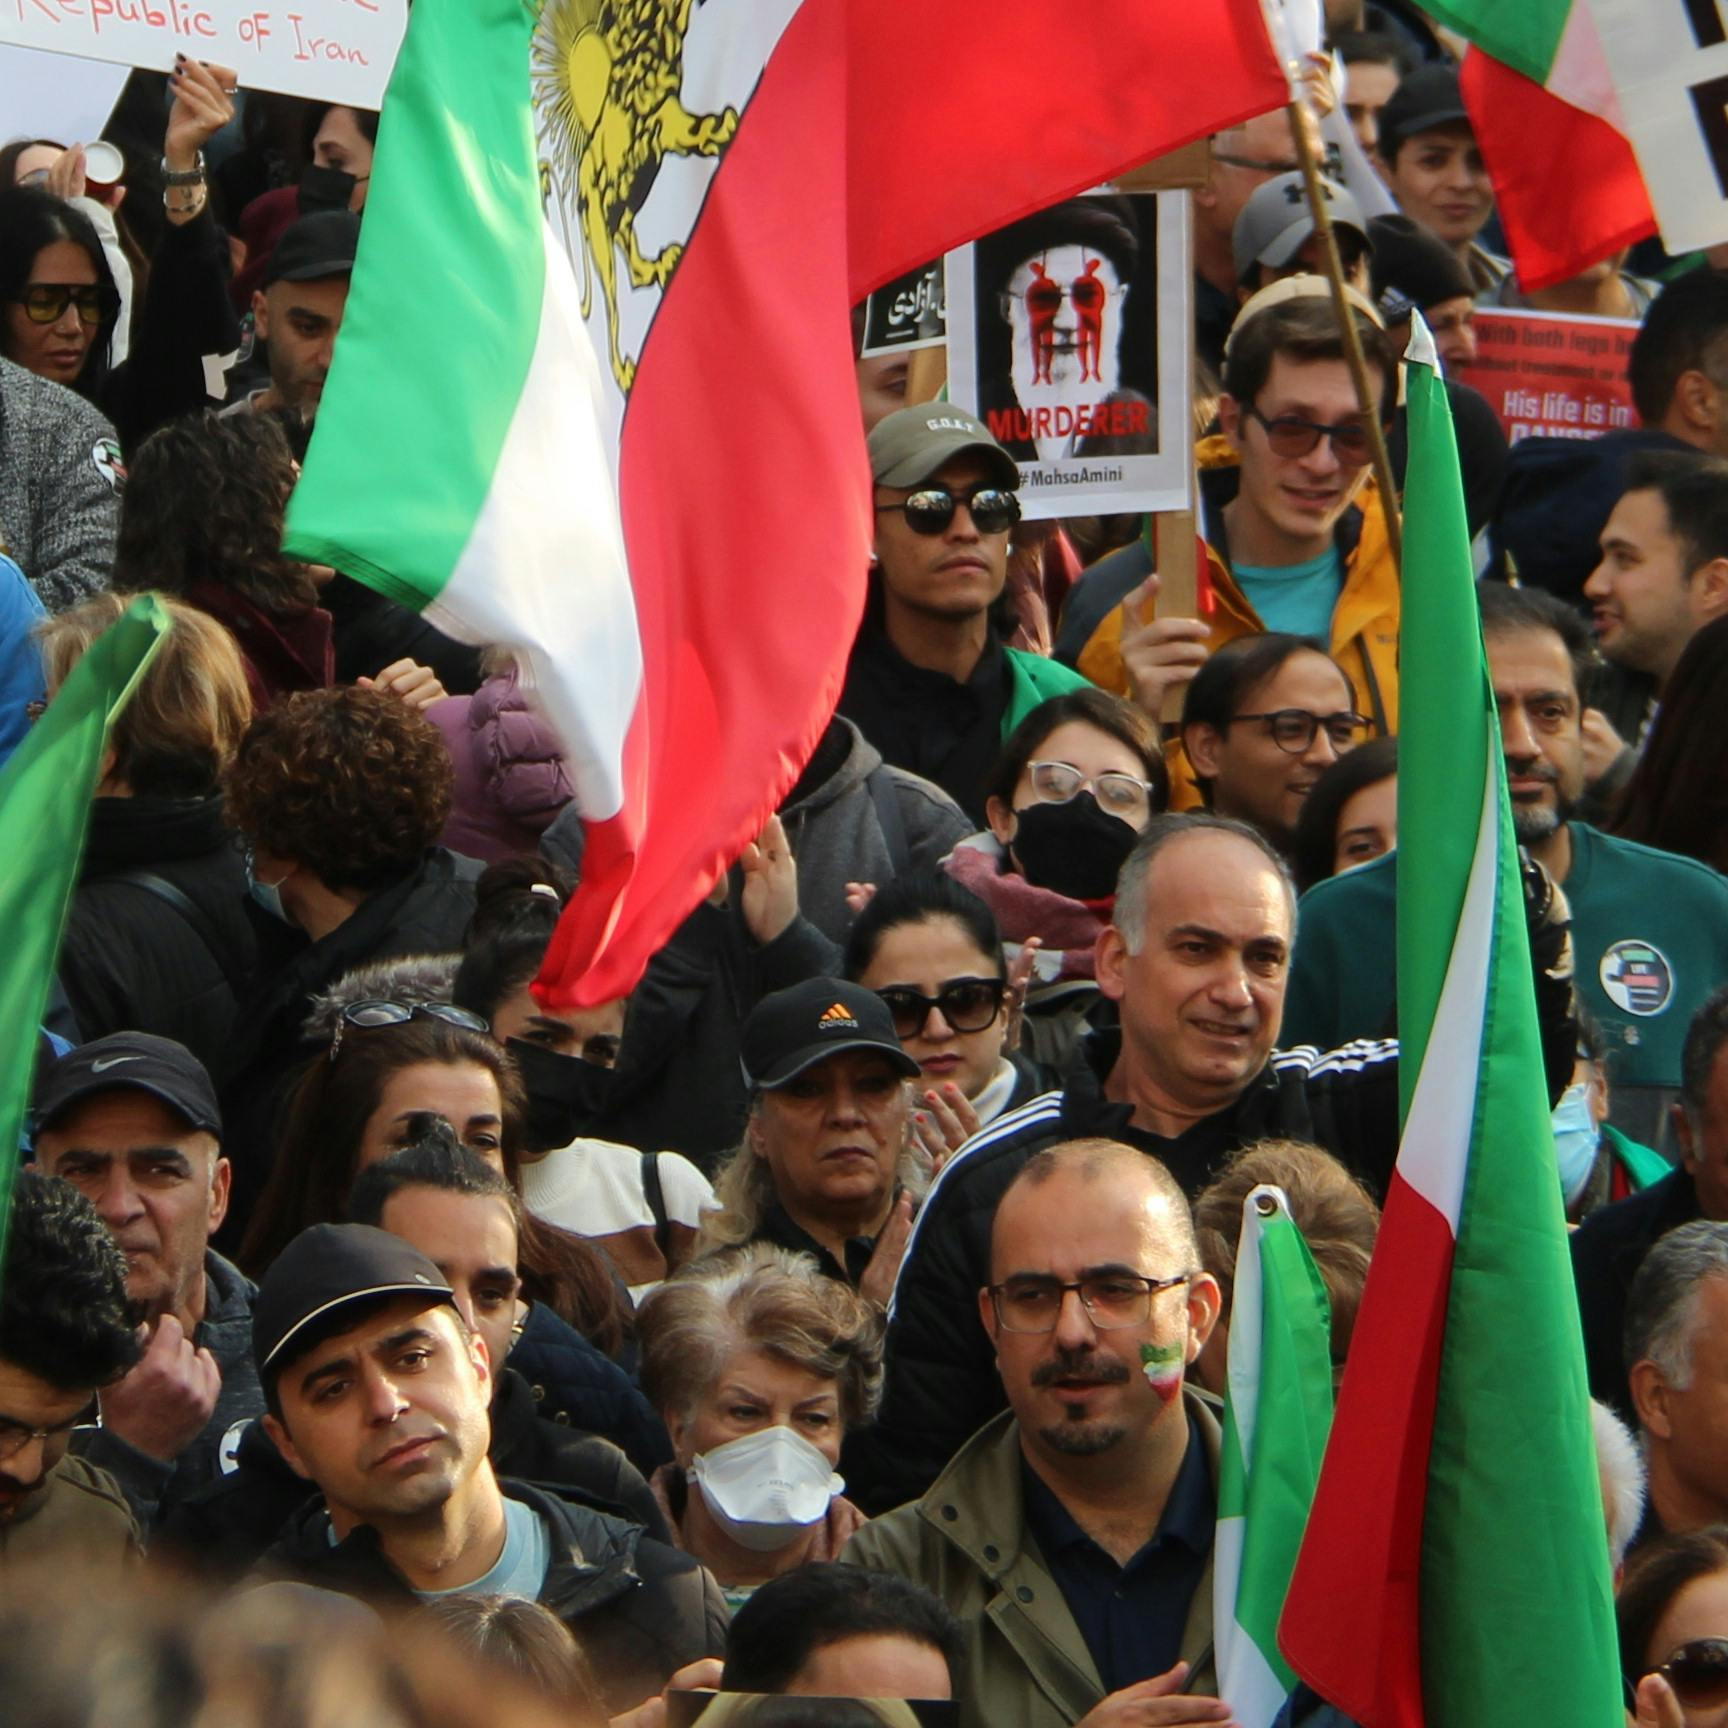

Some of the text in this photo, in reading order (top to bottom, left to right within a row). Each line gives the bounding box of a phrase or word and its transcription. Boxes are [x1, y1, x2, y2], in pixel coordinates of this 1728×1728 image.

[287, 13, 370, 67] Iran
[986, 400, 1150, 443] MURDERER
[1502, 390, 1630, 427] His life is in
[1018, 466, 1124, 488] #MahsaAmini
[818, 1019, 858, 1030] adidas
